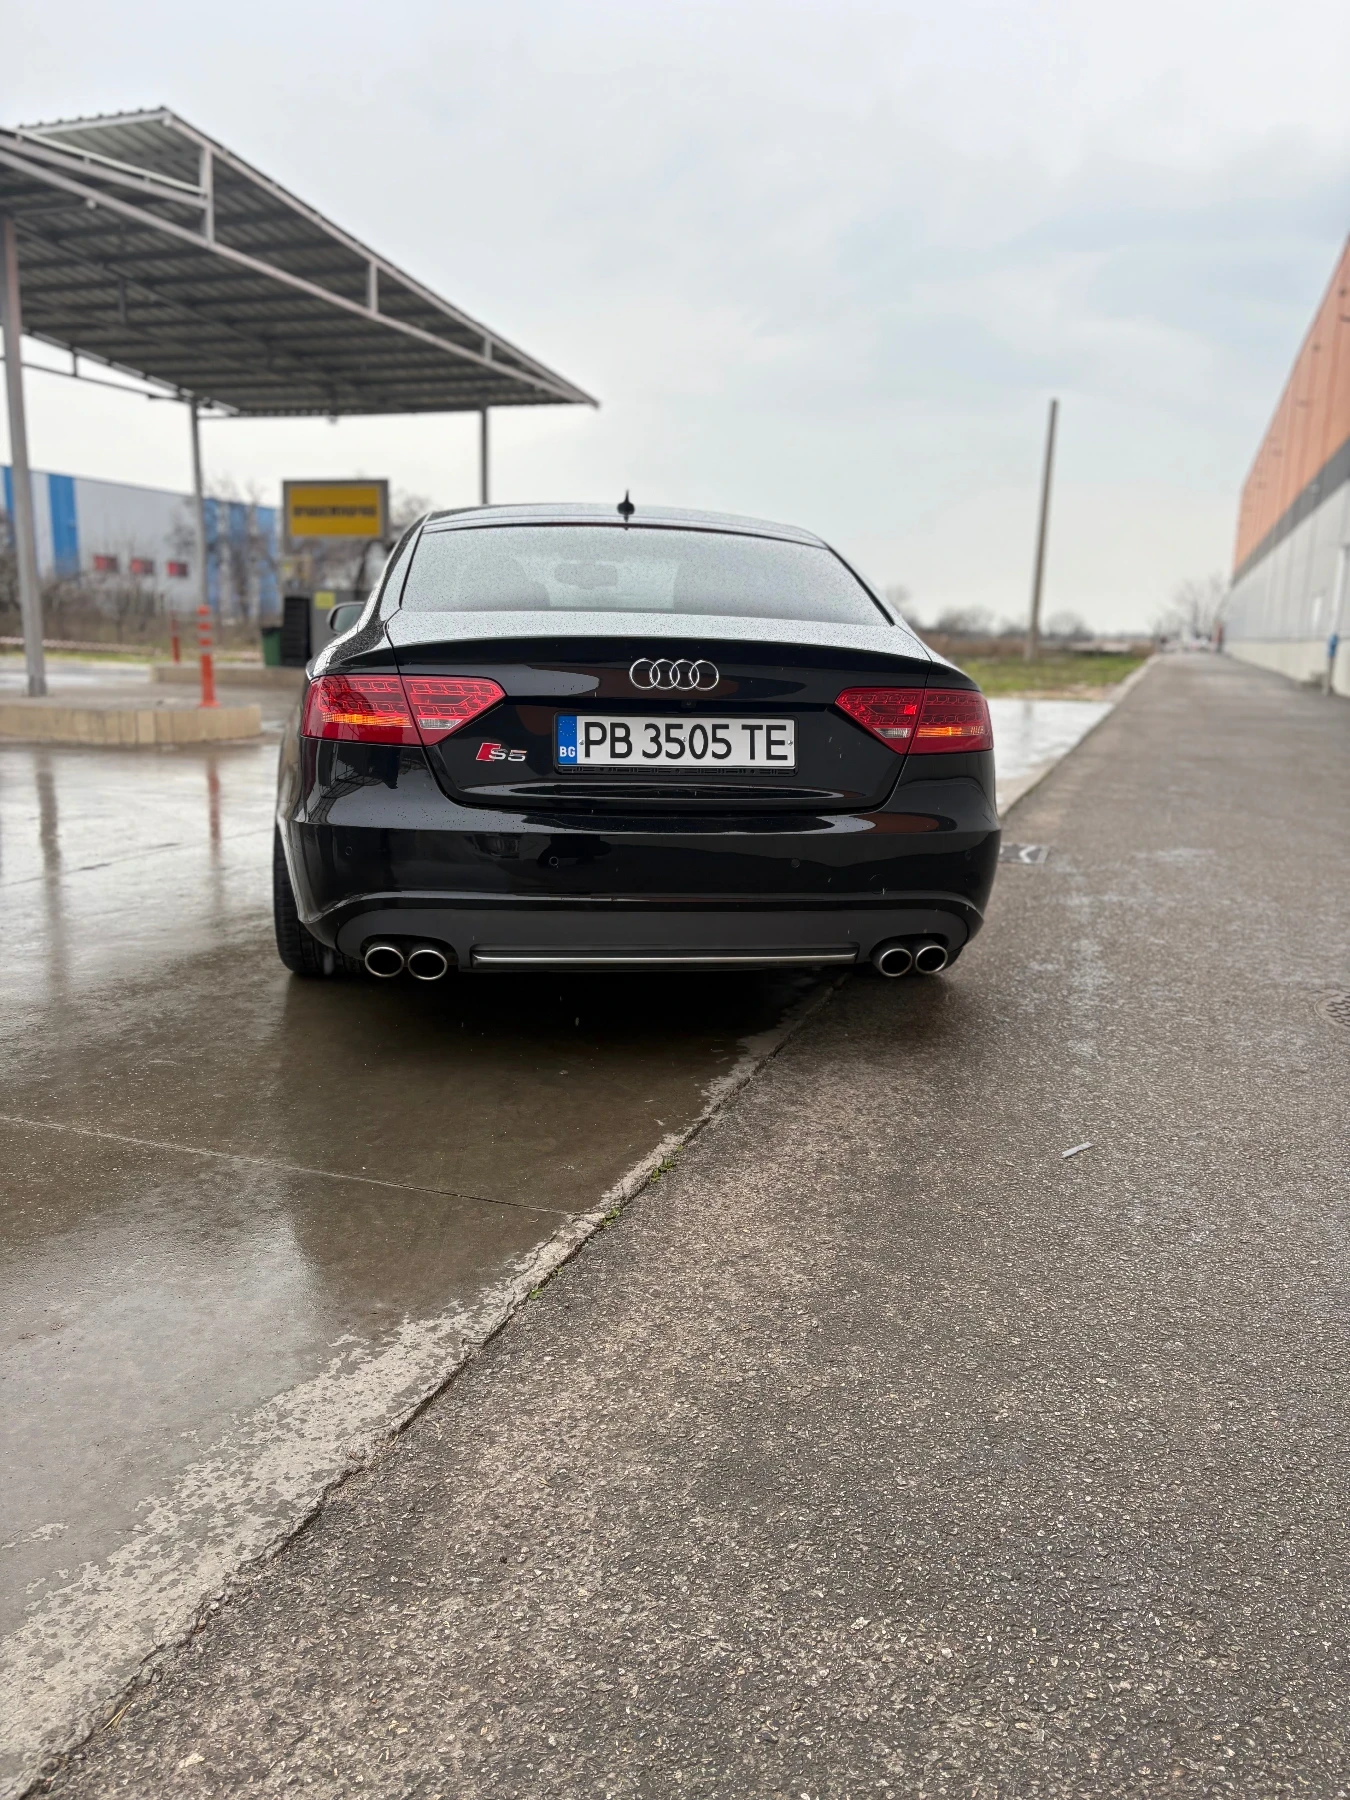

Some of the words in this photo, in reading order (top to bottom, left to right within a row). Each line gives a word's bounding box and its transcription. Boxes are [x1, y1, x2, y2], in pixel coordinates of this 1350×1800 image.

[559, 746, 576, 758] BG
[584, 721, 633, 759] PB
[642, 723, 732, 760] 3505
[741, 724, 788, 761] TE
